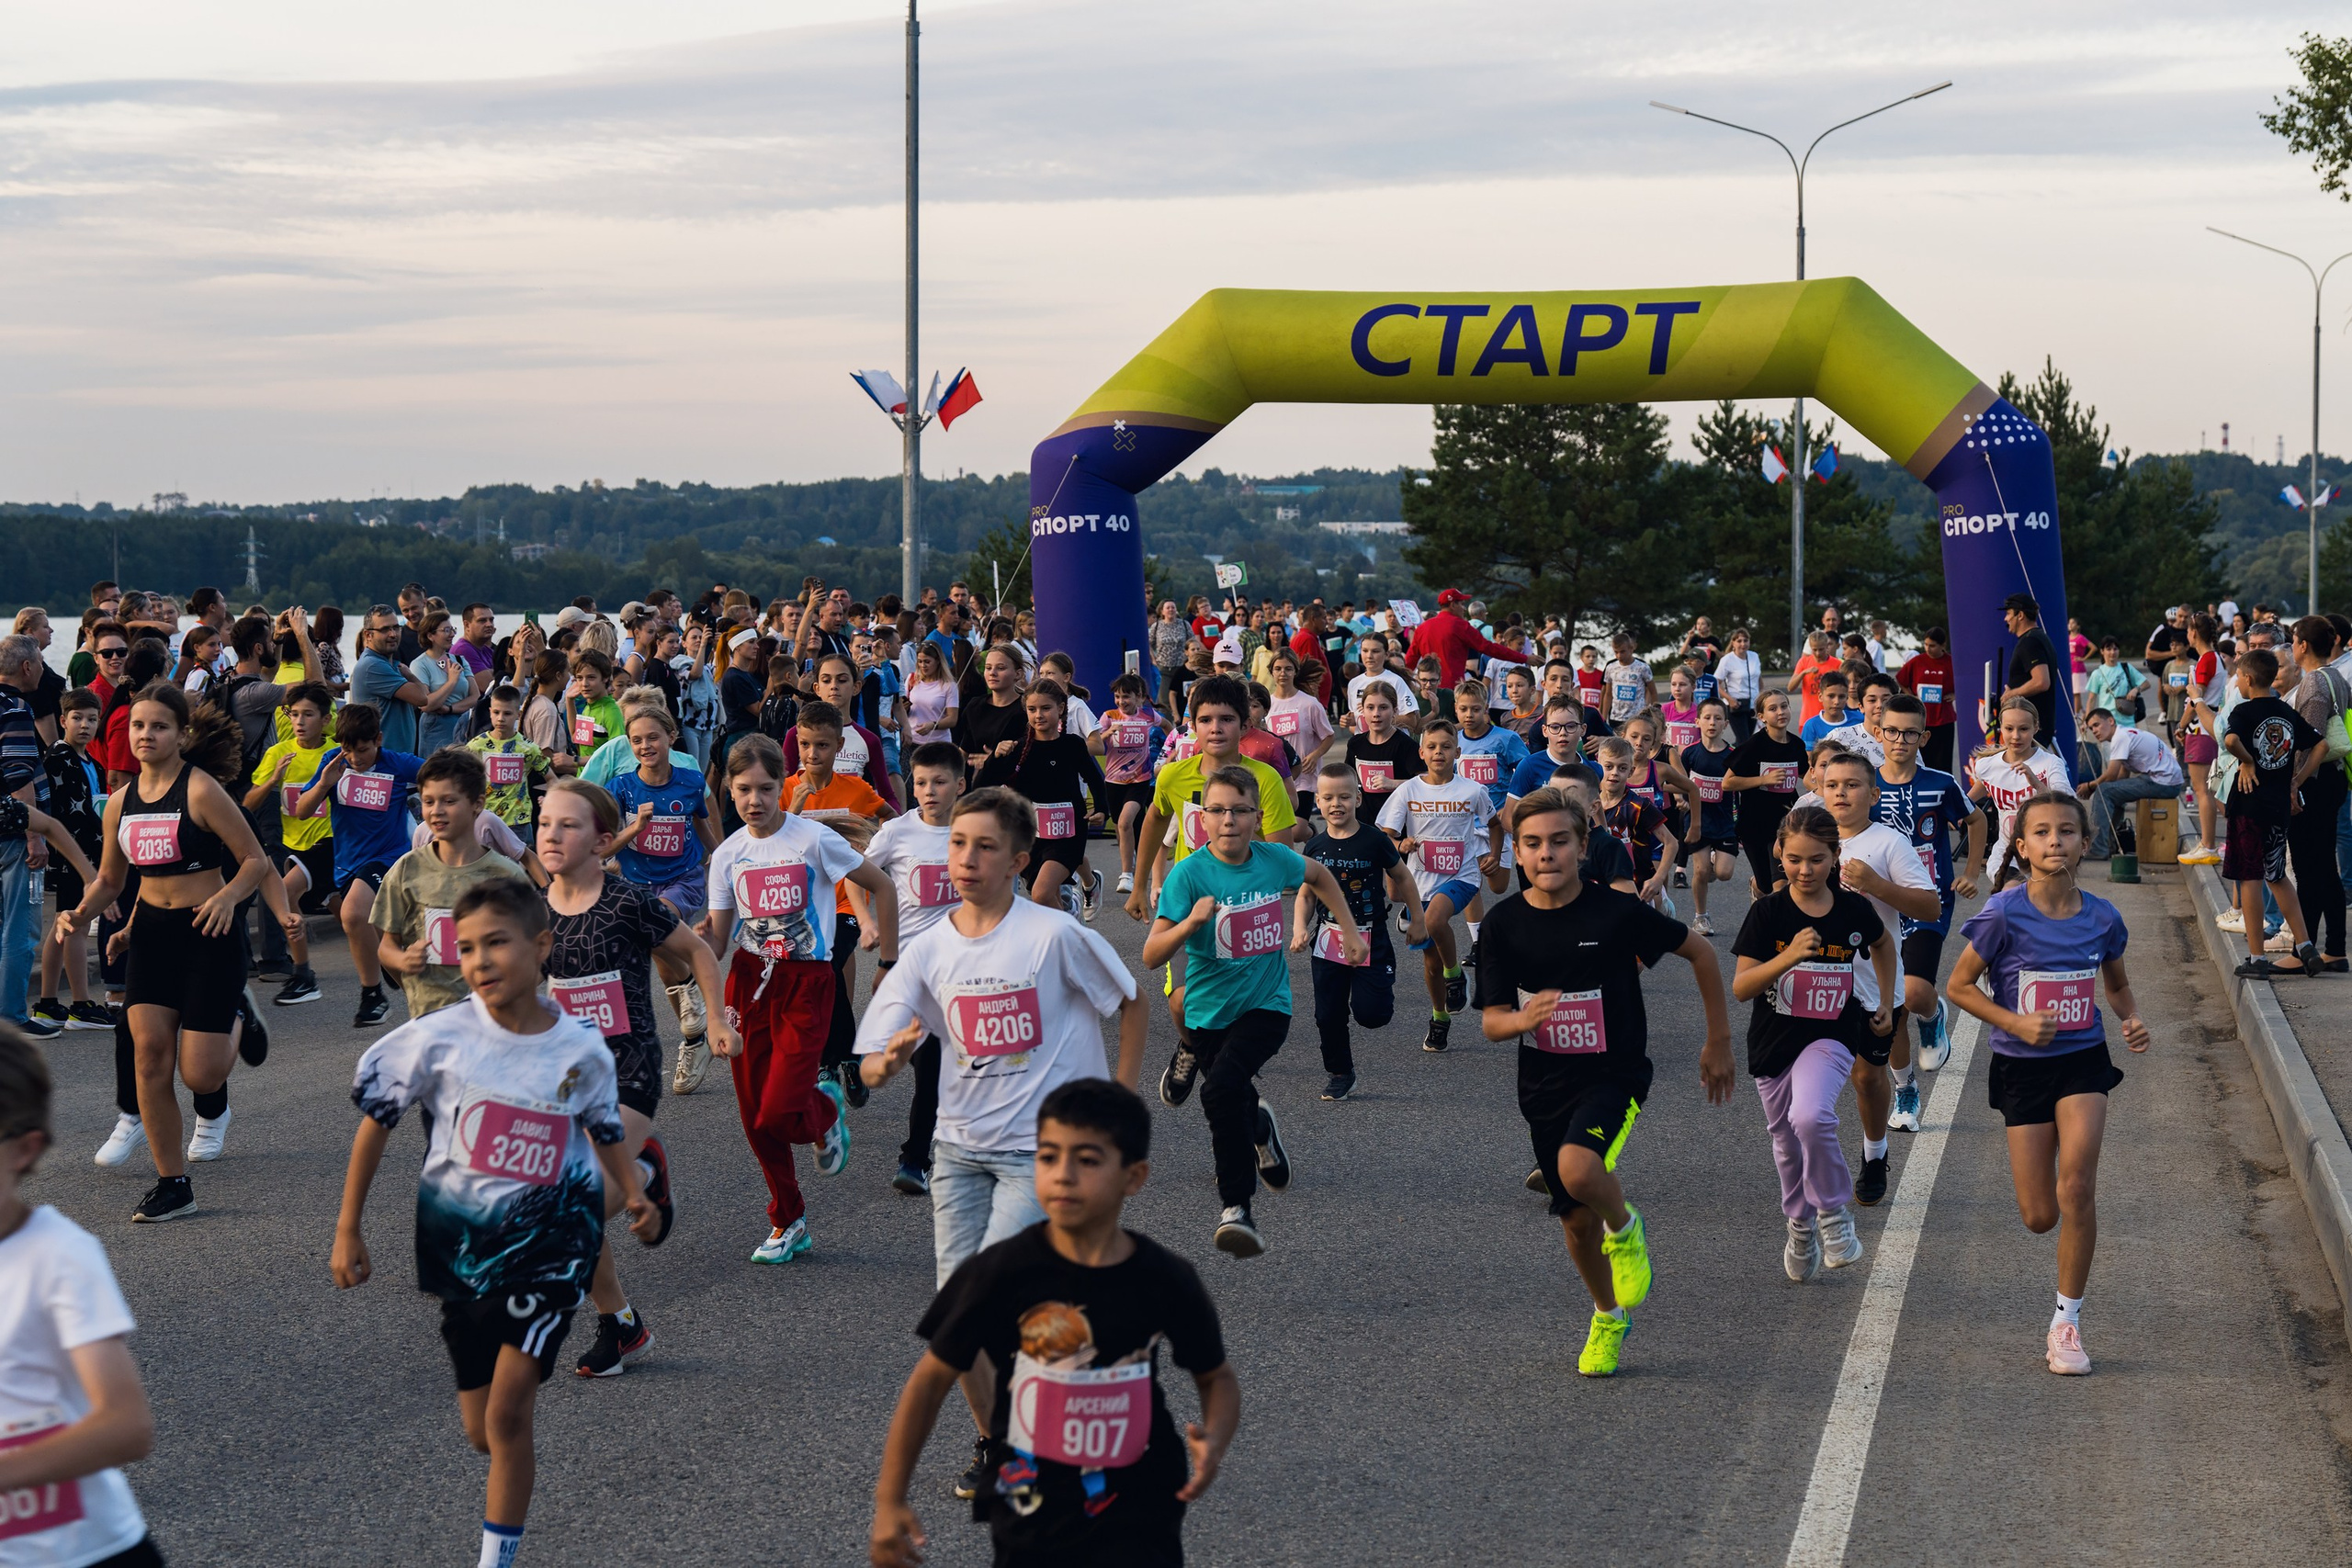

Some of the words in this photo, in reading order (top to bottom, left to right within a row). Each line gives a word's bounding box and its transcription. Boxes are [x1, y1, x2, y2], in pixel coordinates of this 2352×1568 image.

[1351, 301, 1702, 378] СТАРТ
[1032, 505, 1048, 517] PRO
[1943, 503, 1964, 517] PRO
[1032, 514, 1101, 536] СПОРТ
[1104, 514, 1130, 532] 40
[1944, 513, 2019, 536] СПОРТ
[2024, 512, 2050, 530] 40
[1275, 721, 1297, 734] 2894
[1123, 732, 1145, 744] 2768
[496, 768, 520, 781] 1643
[1470, 767, 1495, 781] 5110
[364, 779, 379, 788] ИЛЬЯ
[354, 787, 387, 807] 3695
[1408, 801, 1471, 813] DEMIX
[139, 827, 170, 838] ВЕРОНИКА
[1046, 820, 1070, 836] 1881
[137, 839, 175, 861] 2035
[643, 834, 680, 852] 4873
[1435, 846, 1456, 854] ВИКТОР
[1337, 859, 1372, 869] SYSTEM
[1432, 854, 1461, 871] 1926
[764, 874, 791, 886] СОФЬЯ
[758, 885, 803, 911] 4299
[1253, 912, 1270, 926] ЕГОР
[1241, 921, 1283, 953] 3952
[1812, 976, 1842, 987] УЛЬЯНА
[570, 989, 607, 1004] МАРИНА
[2063, 985, 2078, 997] ЯНА
[978, 997, 1019, 1015] АНДРЕЙ
[1806, 988, 1848, 1012] 1674
[571, 1004, 615, 1029] 759
[1551, 1009, 1587, 1022] ПЛАТОН
[974, 1011, 1035, 1047] 4206
[1546, 1022, 1598, 1048] 1835
[509, 1119, 552, 1142] ДАВИД
[488, 1134, 557, 1178] 3203
[1065, 1392, 1132, 1416] АРСЕНИЙ
[1062, 1417, 1129, 1460] 907
